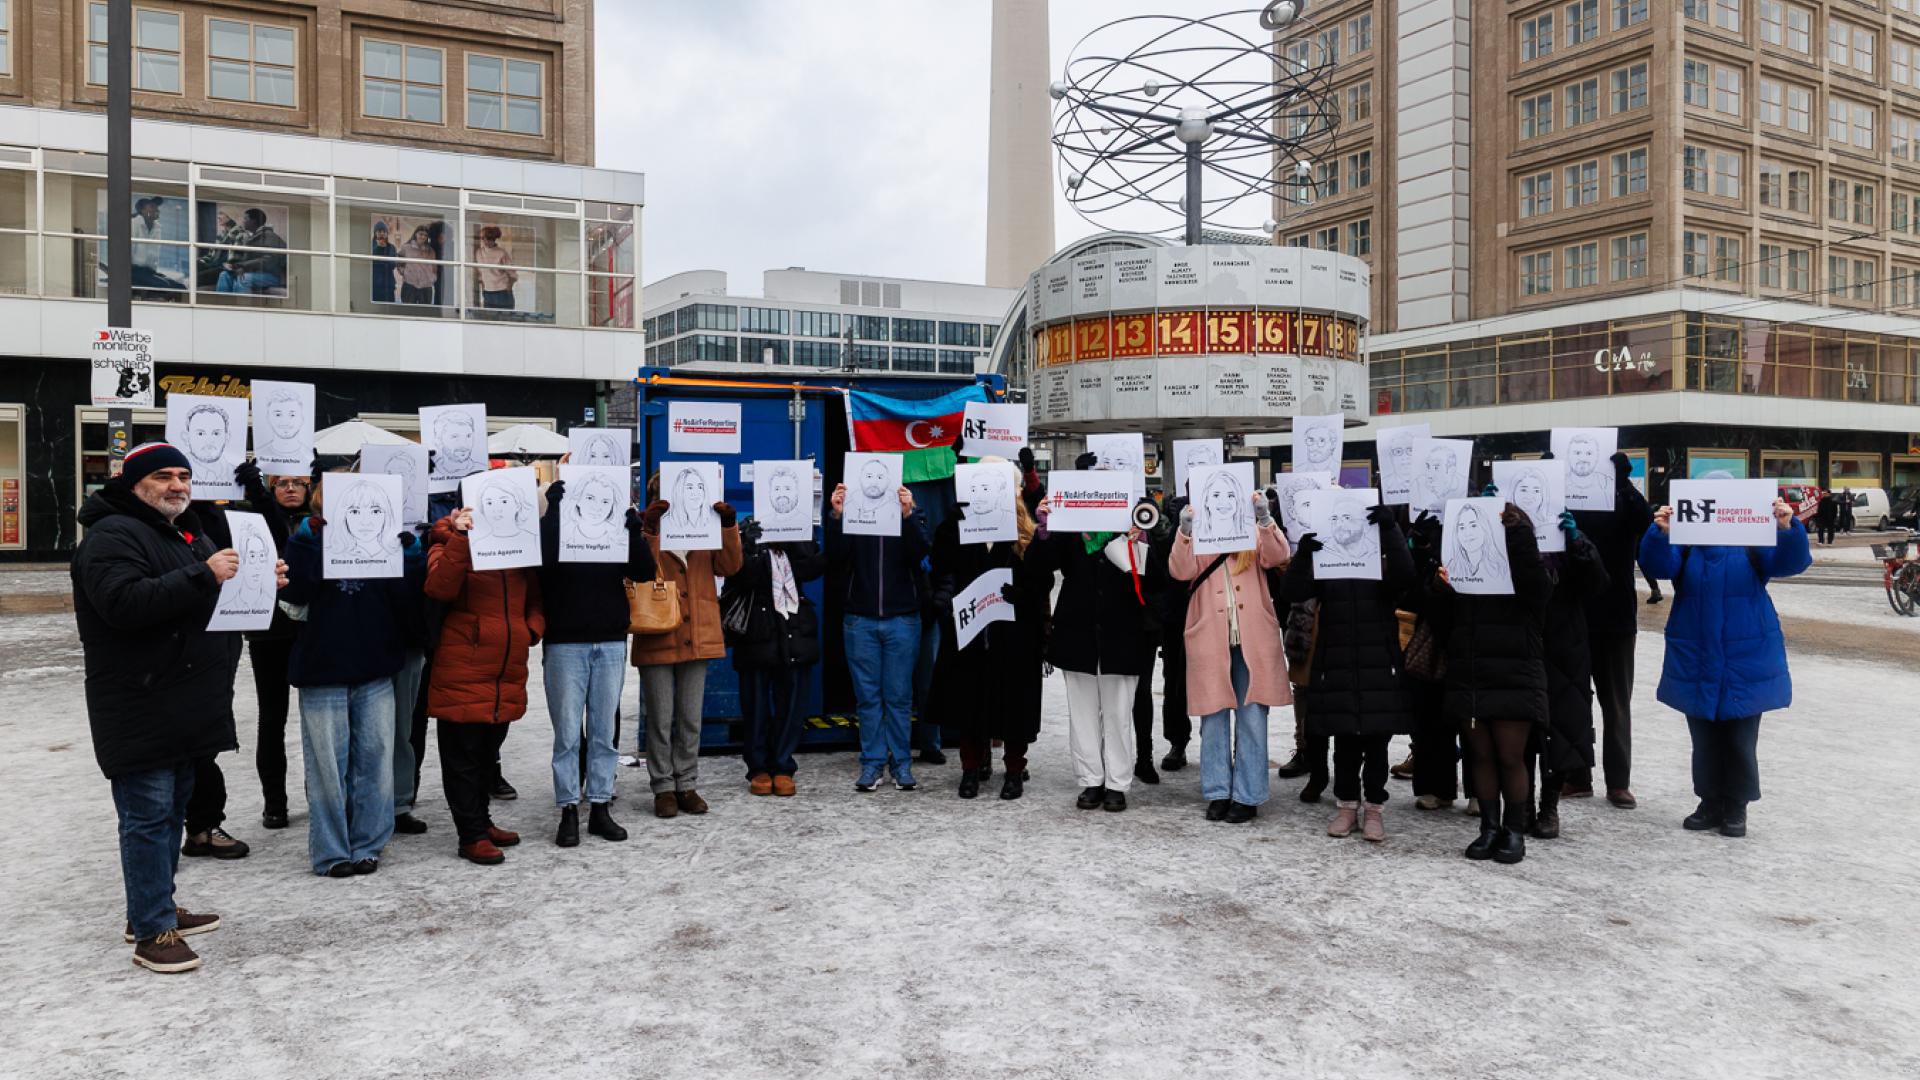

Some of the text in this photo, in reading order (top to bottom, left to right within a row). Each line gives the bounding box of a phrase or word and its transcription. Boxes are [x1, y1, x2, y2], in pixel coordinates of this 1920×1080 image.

[110, 330, 152, 343] Werbe
[1055, 329, 1069, 356] 11
[1079, 324, 1105, 351] 12
[1115, 319, 1146, 348] 13
[1159, 317, 1191, 345] 14
[1208, 317, 1240, 345] 15
[1252, 317, 1284, 345] 16
[1294, 319, 1319, 347] 17
[1326, 323, 1344, 350] 18
[1347, 327, 1357, 353] 19
[93, 341, 148, 352] monitore
[136, 351, 152, 362] ab
[159, 375, 251, 399] Tchib
[673, 418, 737, 432] #NoAirForReporting
[1054, 490, 1128, 508] #NoAirForReporting
[1677, 499, 1716, 523] RSF
